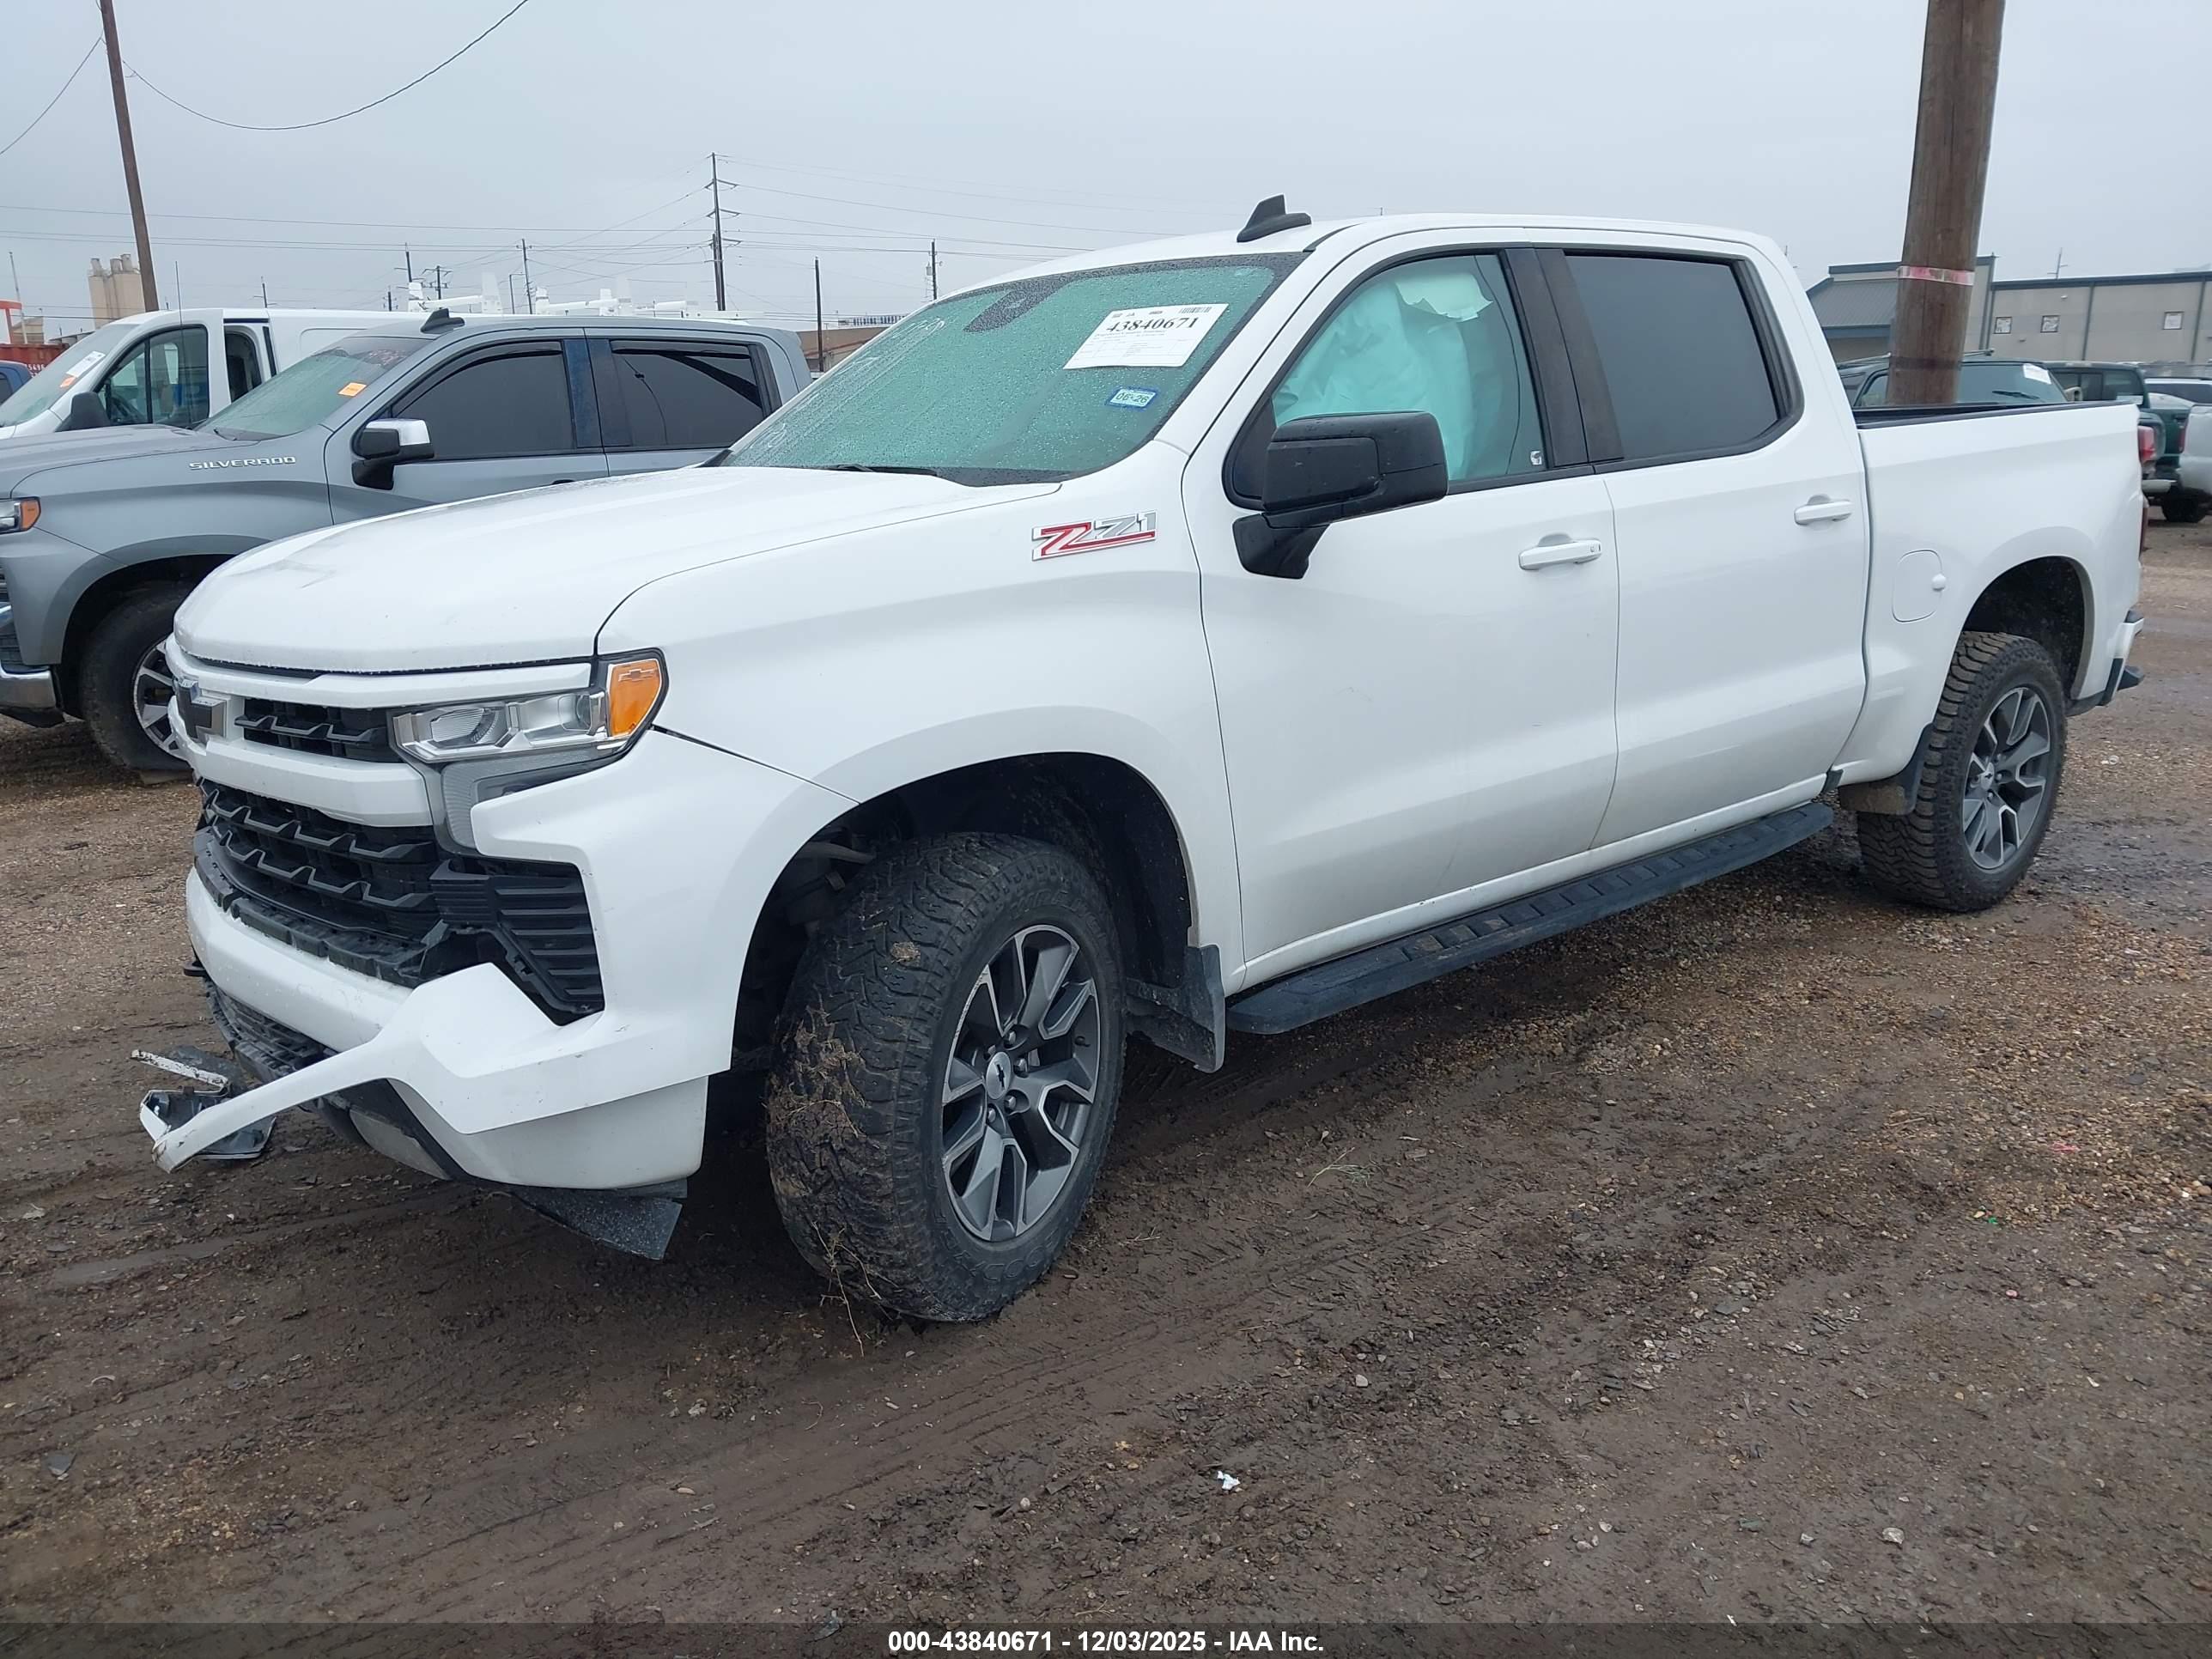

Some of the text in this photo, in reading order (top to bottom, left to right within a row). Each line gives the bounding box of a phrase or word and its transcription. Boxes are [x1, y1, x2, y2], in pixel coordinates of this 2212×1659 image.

[1106, 316, 1199, 332] 43840671
[189, 456, 296, 470] SILVERADO
[1031, 509, 1158, 562] Z71
